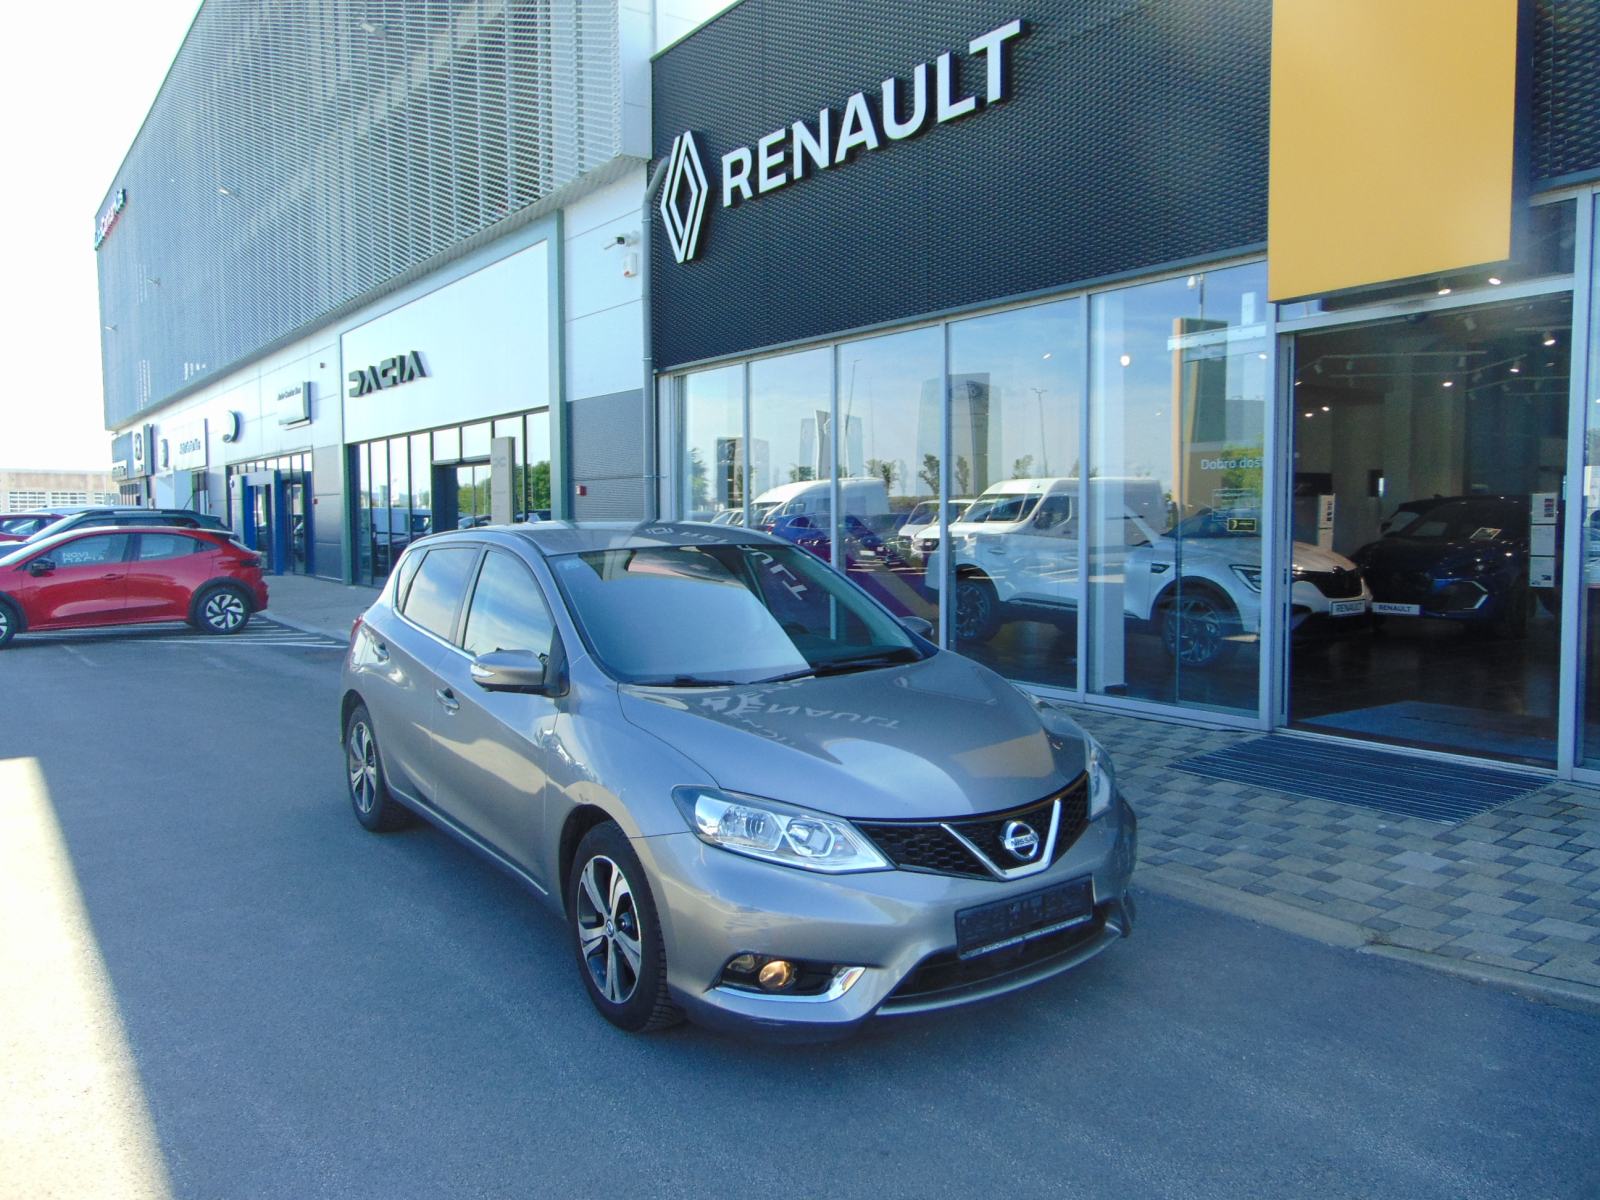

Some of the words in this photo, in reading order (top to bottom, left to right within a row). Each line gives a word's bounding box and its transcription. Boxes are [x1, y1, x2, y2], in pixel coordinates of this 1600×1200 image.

[722, 19, 1022, 208] RENAULT
[348, 350, 427, 397] DACIA
[1200, 458, 1236, 470] Dobro
[1378, 604, 1413, 613] RENAULT
